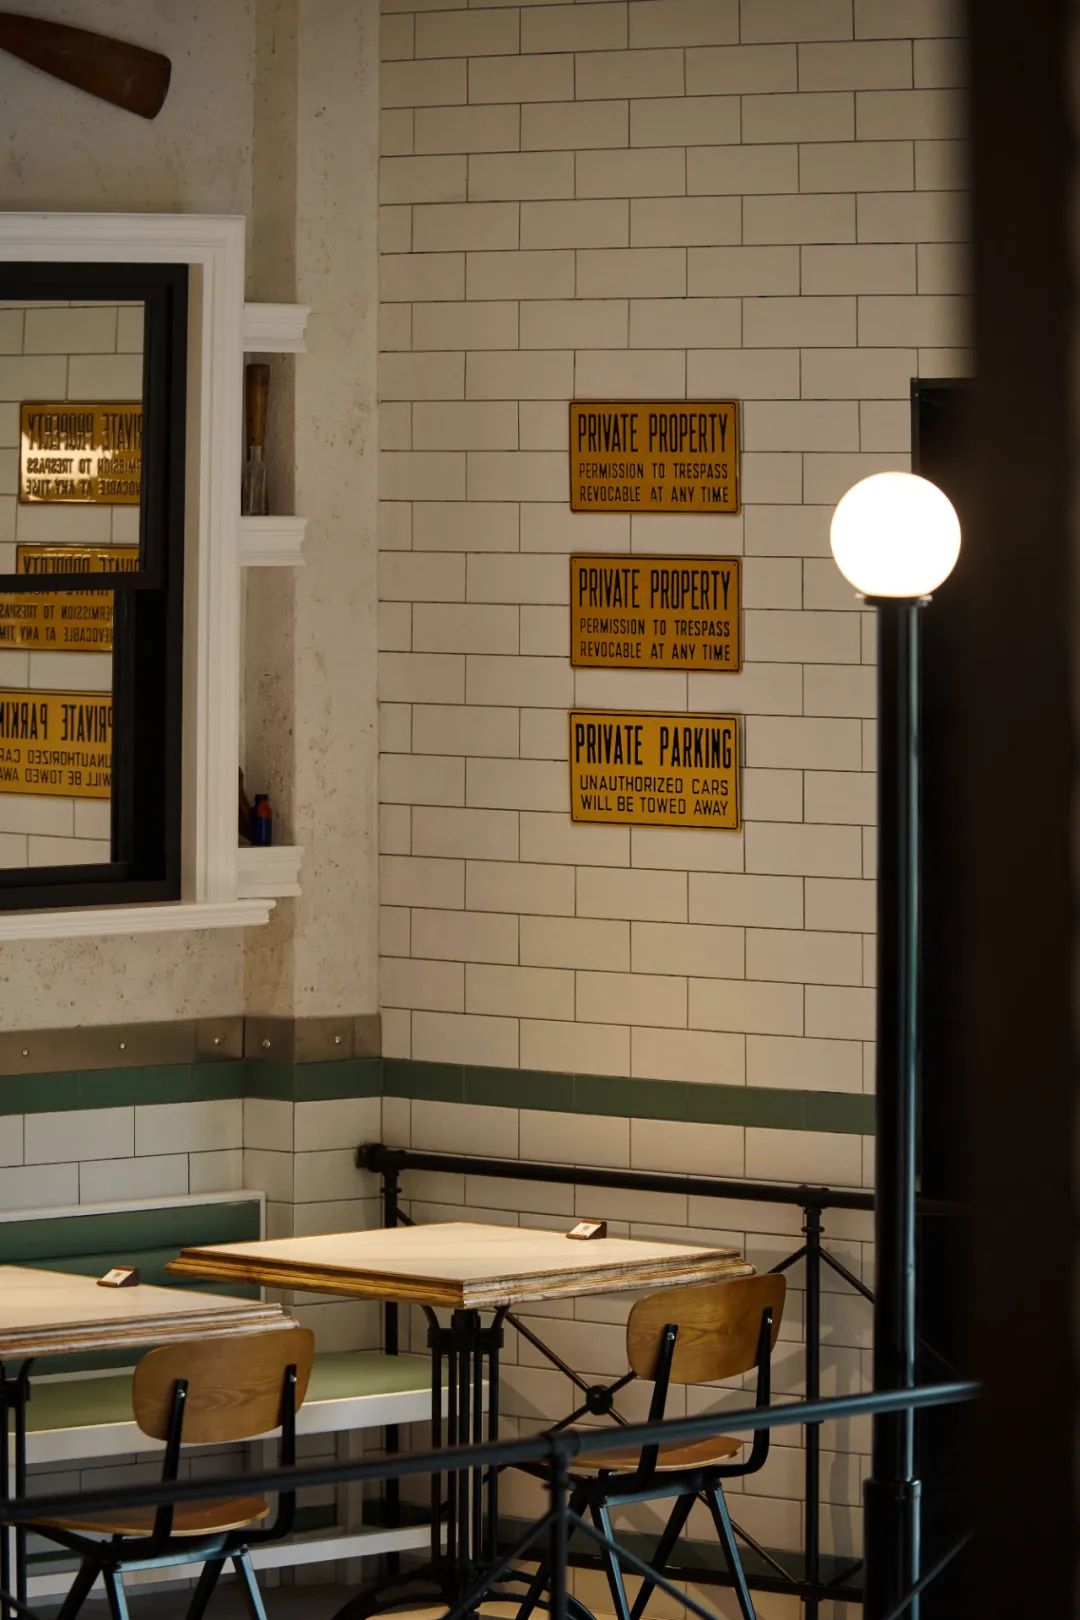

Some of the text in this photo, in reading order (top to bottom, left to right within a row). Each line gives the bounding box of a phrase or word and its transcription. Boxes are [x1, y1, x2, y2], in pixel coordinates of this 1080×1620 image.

[578, 413, 728, 453] PRIVATE PROPERTY
[579, 463, 728, 479] PERMISSION TO TRESPASS
[579, 486, 729, 503] REVOCABLE AT ANY TIME
[579, 568, 731, 611] PRIVATE PROPERTY
[580, 618, 730, 637] PERMISSION TO TRESPASS
[580, 641, 730, 661] REVOCABLE AT ANY TIME
[575, 723, 732, 769] PRIVATE PARKING
[580, 775, 729, 796] UNAUTHORIZED CARS
[581, 794, 729, 817] WILL BE TOWED AWAY
